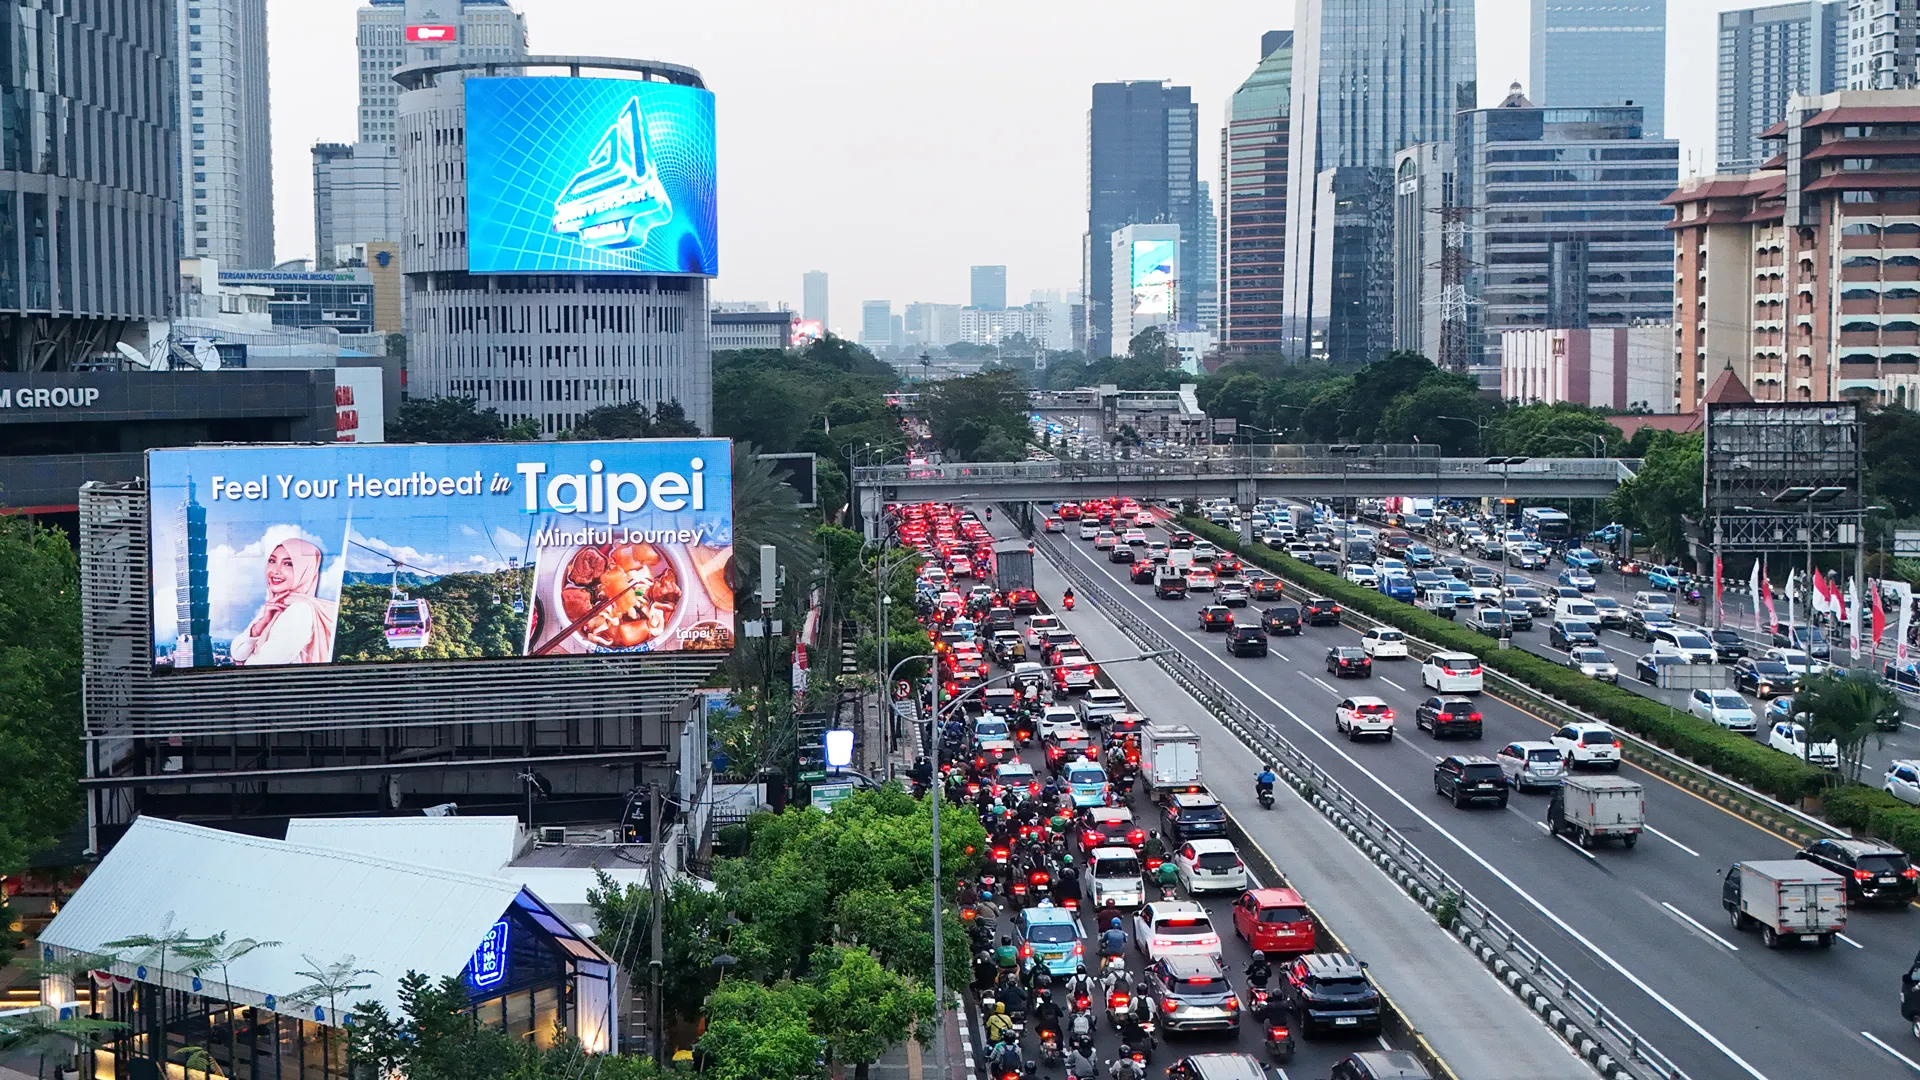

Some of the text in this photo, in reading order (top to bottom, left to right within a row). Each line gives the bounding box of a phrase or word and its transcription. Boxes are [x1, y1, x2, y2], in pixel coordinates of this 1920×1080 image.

[246, 272, 282, 280] INVESTASI
[16, 387, 99, 408] GROUP
[212, 457, 704, 525] Feel Your Heartbeat in Taipei
[535, 527, 704, 548] Mindful Journey
[676, 627, 714, 641] taipei
[484, 951, 495, 962] NA
[484, 961, 495, 972] KO
